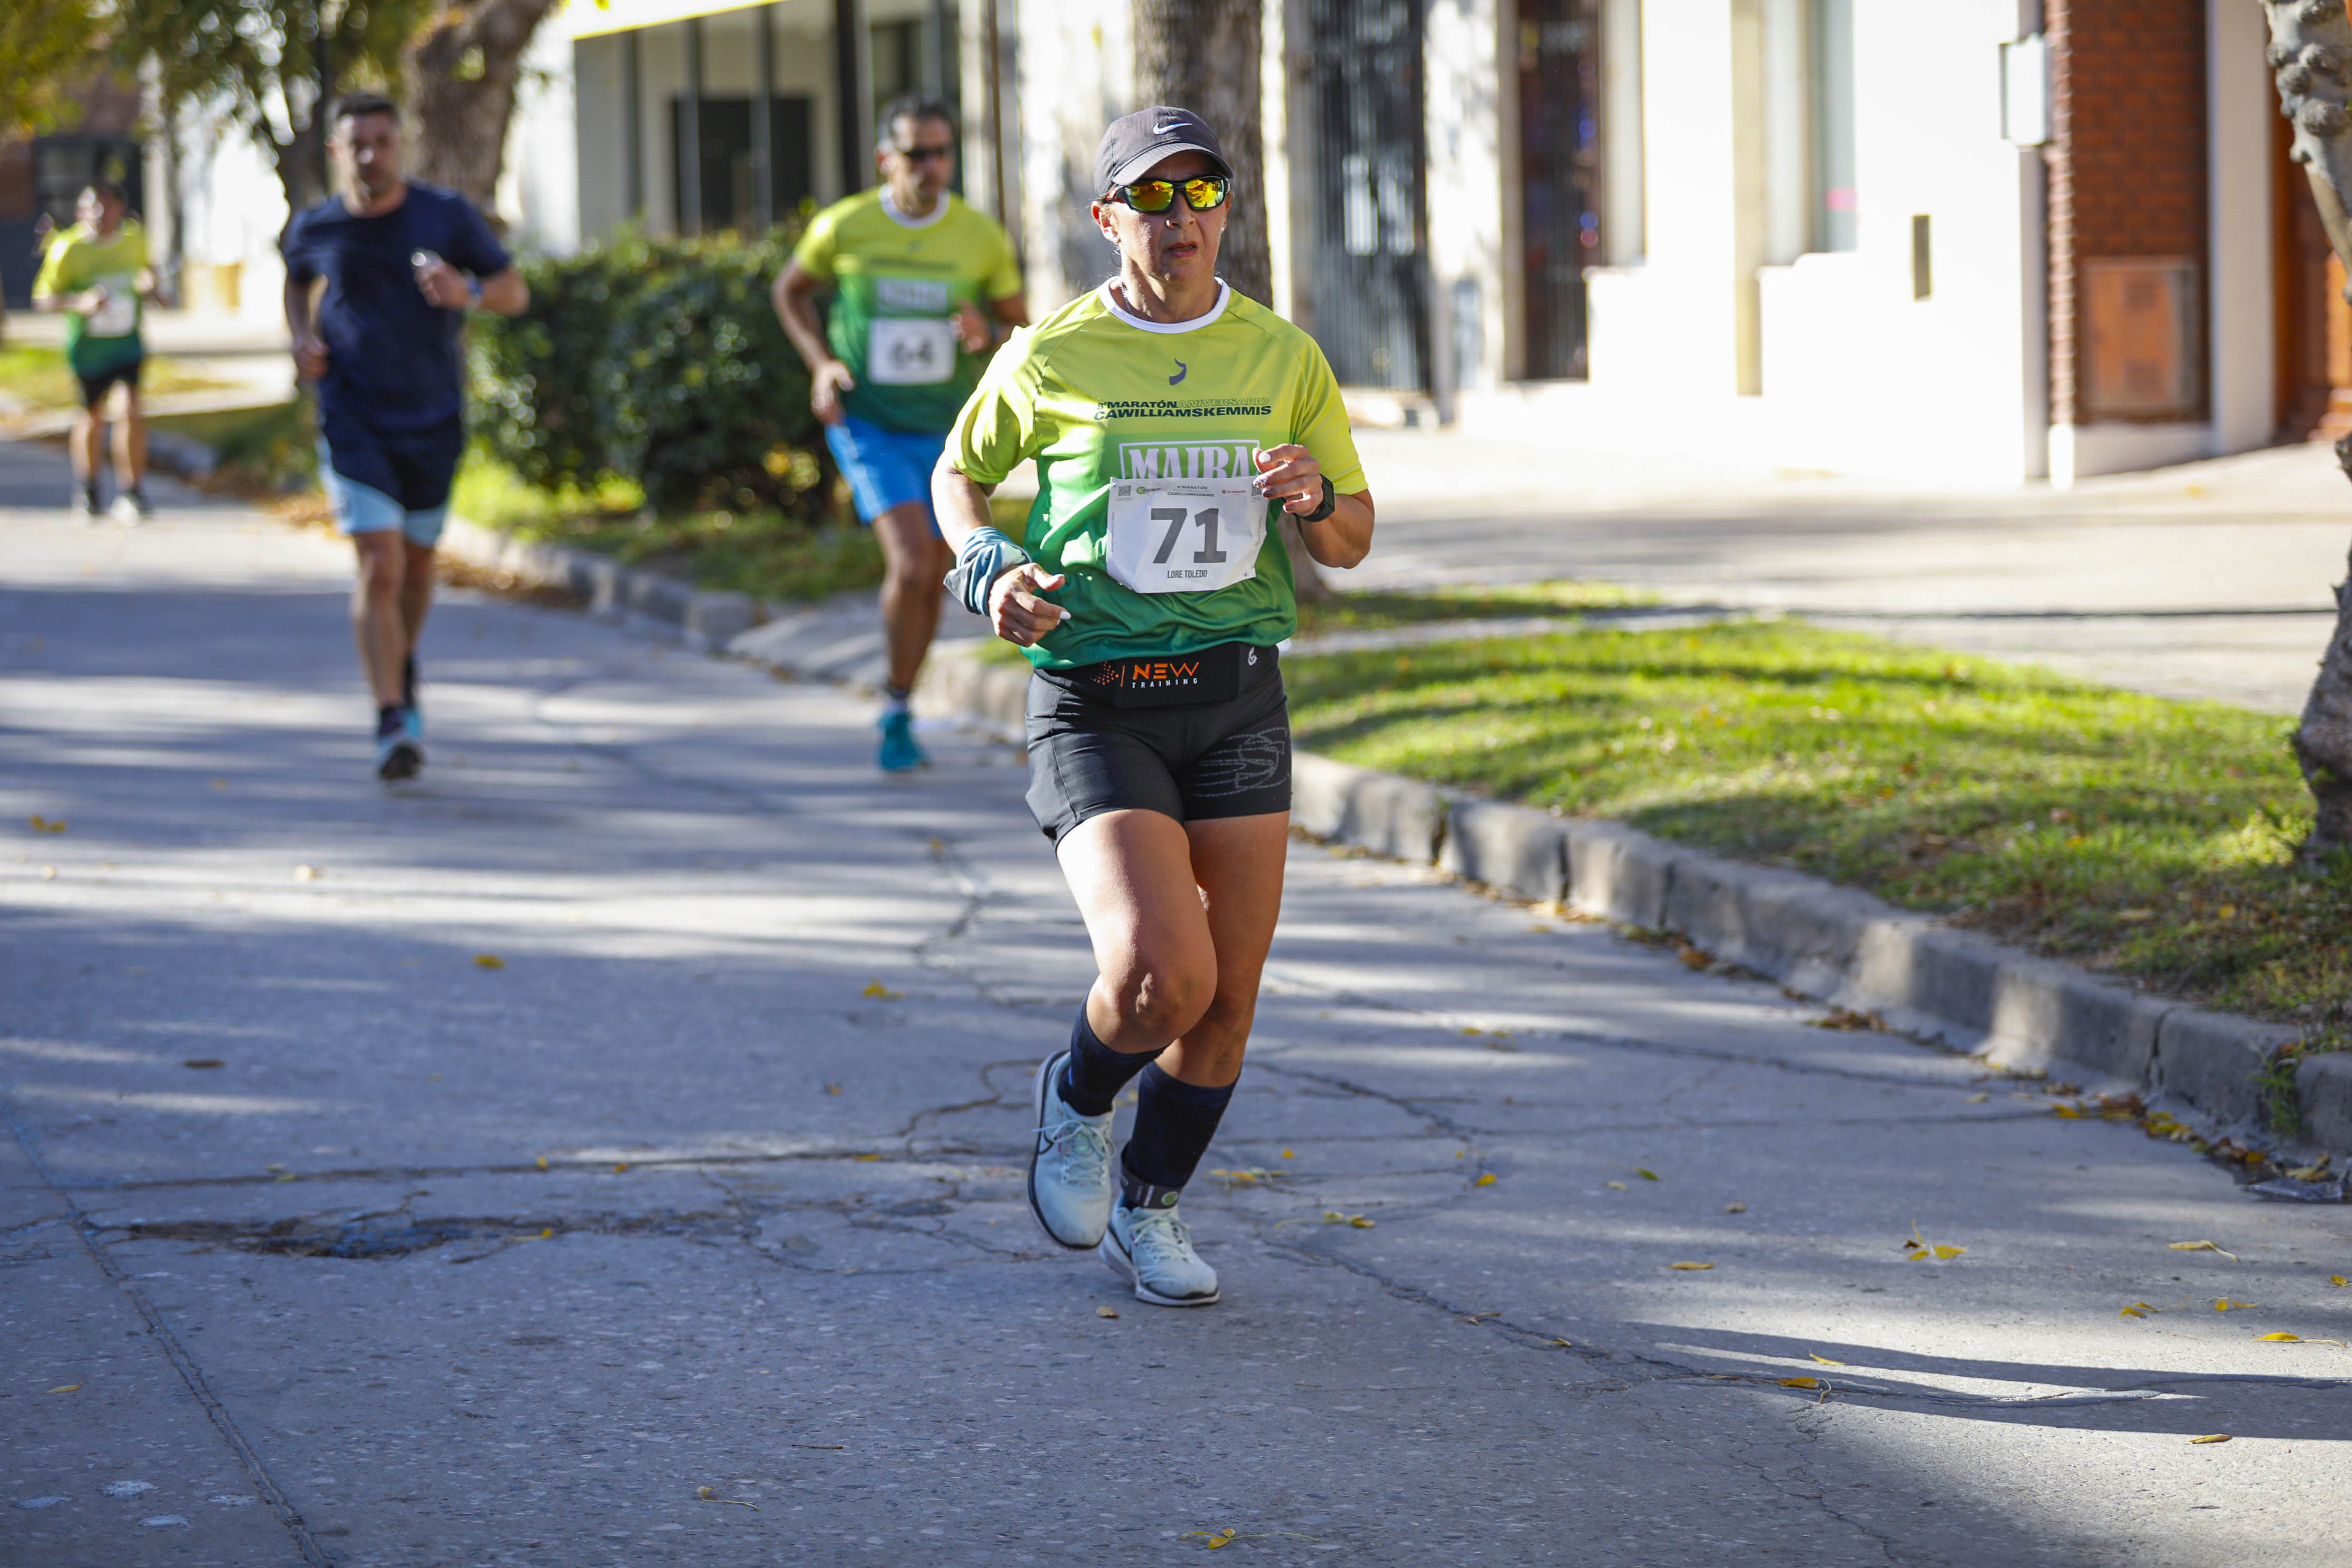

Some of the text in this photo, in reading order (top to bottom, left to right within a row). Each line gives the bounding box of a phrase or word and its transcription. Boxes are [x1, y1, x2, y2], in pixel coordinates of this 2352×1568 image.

[1151, 508, 1227, 564] 71
[1168, 570, 1208, 579] LORE TOLEDO
[1133, 662, 1200, 680] NEW
[1132, 678, 1198, 689] TRAINING
